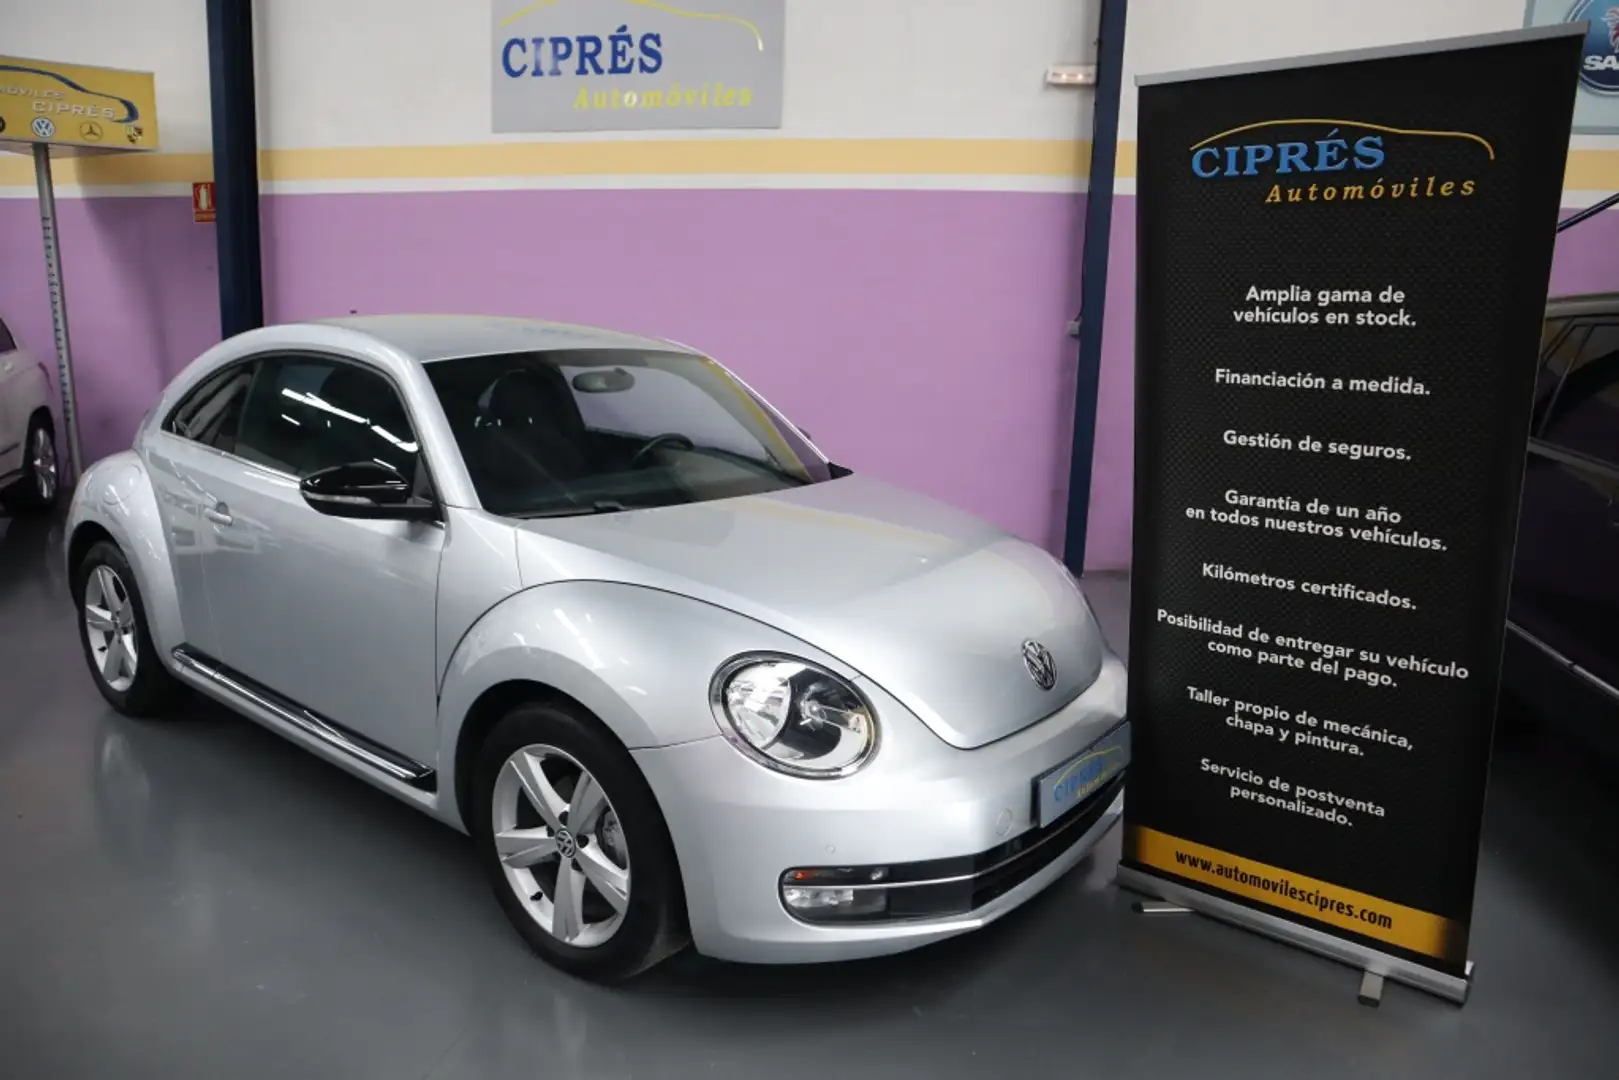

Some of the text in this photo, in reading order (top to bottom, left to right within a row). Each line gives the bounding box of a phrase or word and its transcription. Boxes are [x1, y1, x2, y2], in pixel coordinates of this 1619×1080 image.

[502, 24, 663, 78] CIPRÉS
[1583, 55, 1619, 70] SA
[573, 82, 752, 110] Automóviles
[1191, 127, 1385, 179] CIPRÉS
[1264, 176, 1476, 203] Automóviles
[1233, 305, 1417, 327] vehículos en stock.
[1245, 284, 1406, 307] Amplia gama de
[1215, 368, 1431, 395] Financiación a medida.
[1223, 429, 1412, 461] Gestión de seguros.
[1224, 489, 1402, 524] Garantía de un año
[1185, 507, 1447, 551] en todos nuestros vehículos.
[1202, 562, 1417, 610] Kilómetros certificados.
[1157, 608, 1469, 679] Posibilidad de entregar su vehículo
[1207, 641, 1398, 687] como parte del pago.
[1187, 686, 1414, 751] Taller propio de mecánica,
[1225, 713, 1364, 756] chapa y pintura.
[1201, 758, 1386, 818] Servicio de postventa
[1229, 784, 1354, 827] personalizado.
[1174, 849, 1394, 930] www.automovilescipres.com
